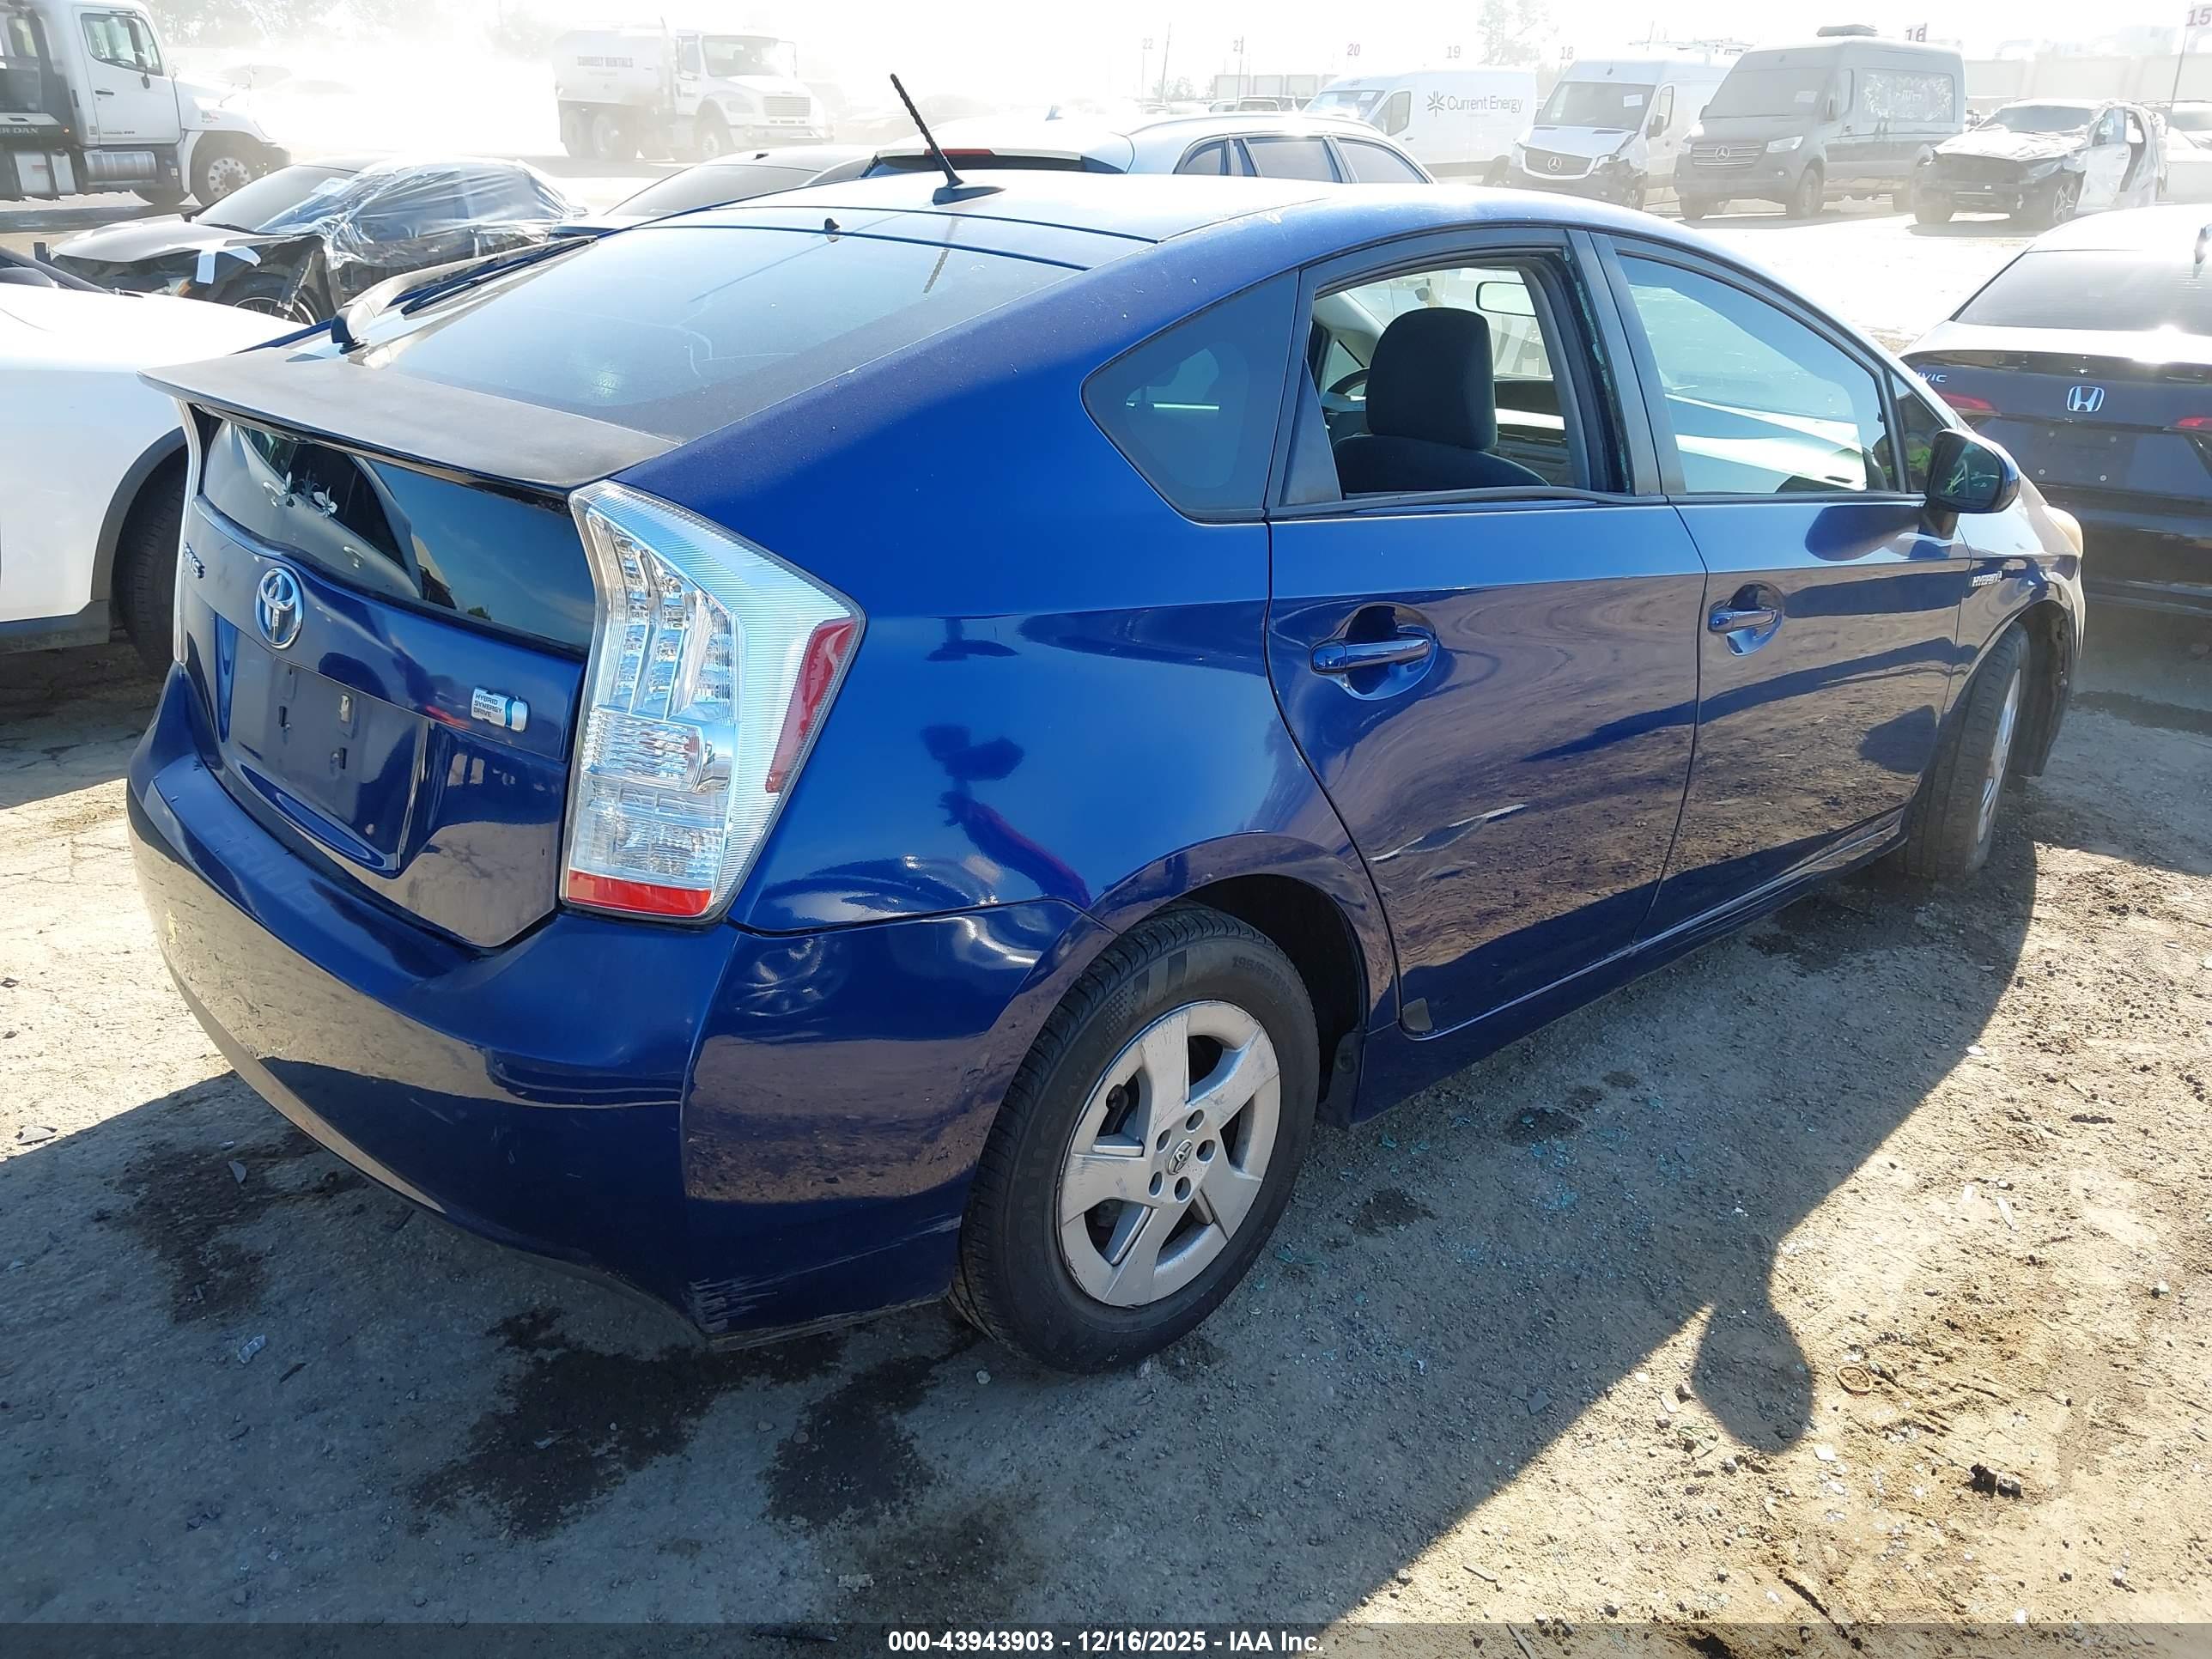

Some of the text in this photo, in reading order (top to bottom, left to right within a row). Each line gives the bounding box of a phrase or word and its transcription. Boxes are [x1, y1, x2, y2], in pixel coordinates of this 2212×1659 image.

[2185, 8, 2212, 27] 15
[1142, 38, 1153, 50] 22
[1346, 43, 1360, 56] 20
[1445, 46, 1461, 58] 19
[1559, 46, 1573, 59] 18
[1447, 95, 1523, 113] Current Energy
[475, 693, 498, 706] HYBRID
[473, 700, 503, 714] SYNERGY
[473, 707, 492, 718] DRIVE
